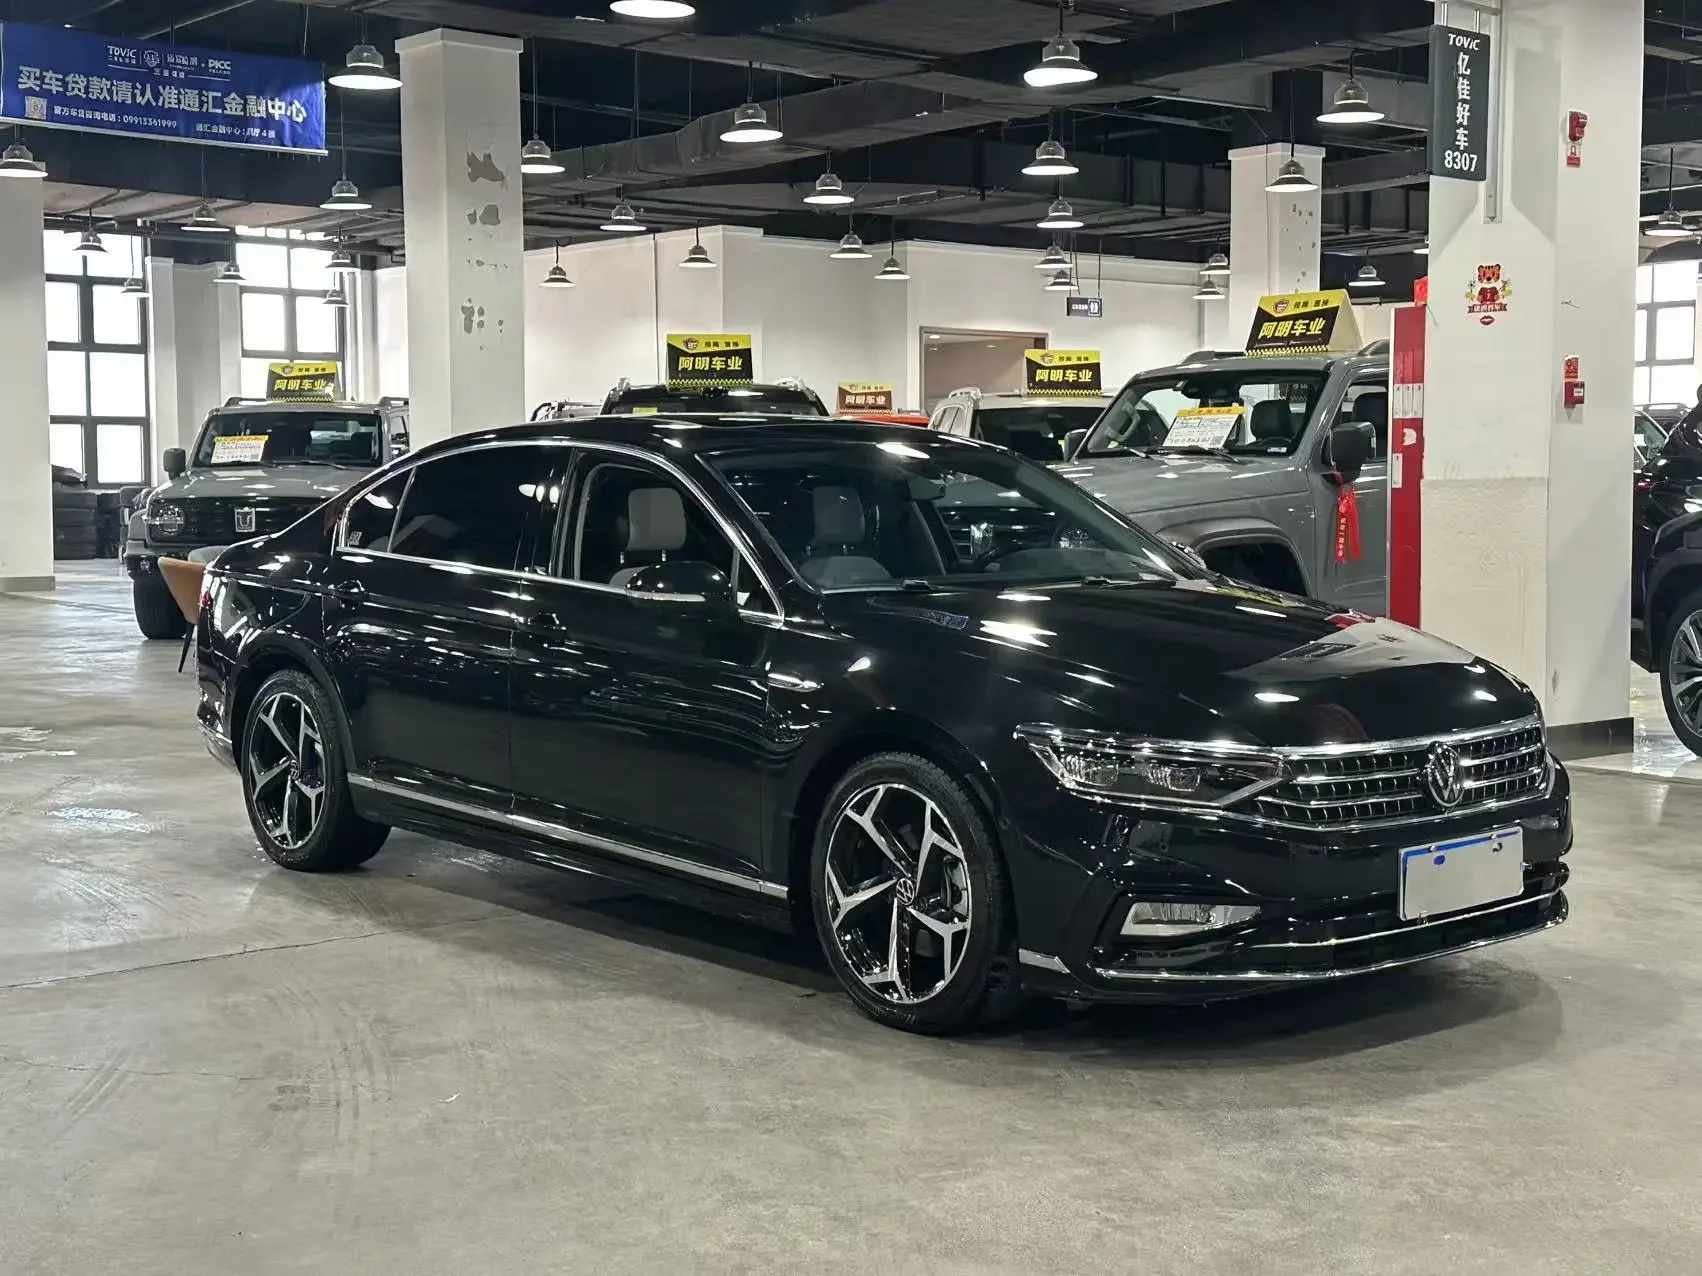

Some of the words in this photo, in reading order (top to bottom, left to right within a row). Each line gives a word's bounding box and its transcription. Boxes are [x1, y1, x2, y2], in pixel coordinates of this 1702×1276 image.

[1448, 33, 1480, 51] TOVIC
[107, 45, 137, 58] TOVIC
[208, 58, 231, 70] PICC
[17, 65, 307, 123] 买车贷款请认准通汇金融中心
[1455, 51, 1471, 150] 亿佳好车
[1444, 149, 1478, 172] 8307
[1257, 316, 1326, 340] 阿明车业
[677, 356, 743, 371] 阿明车业
[1035, 368, 1093, 383] 阿明车业
[274, 378, 327, 391] 阿明车业
[845, 394, 886, 406] 阿明车业
